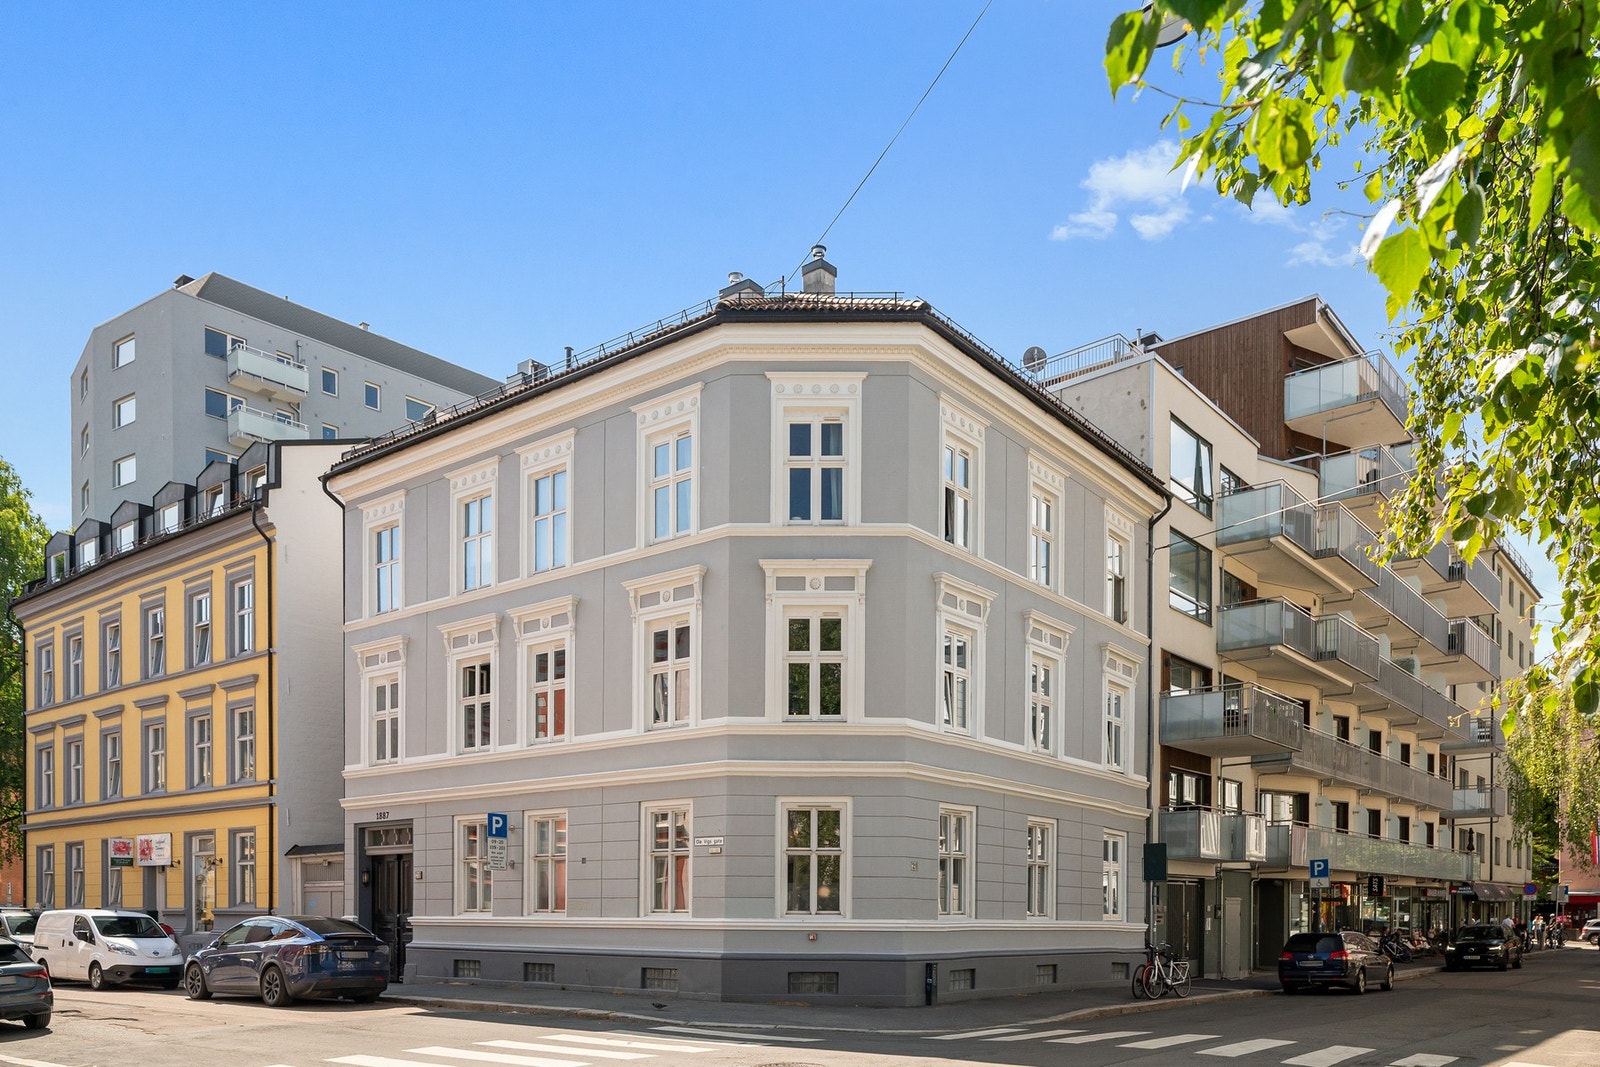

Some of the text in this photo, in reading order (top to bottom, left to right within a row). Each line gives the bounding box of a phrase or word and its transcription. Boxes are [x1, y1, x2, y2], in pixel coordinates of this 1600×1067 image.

[376, 811, 390, 820] 1887
[492, 816, 503, 835] P
[1314, 861, 1325, 876] P
